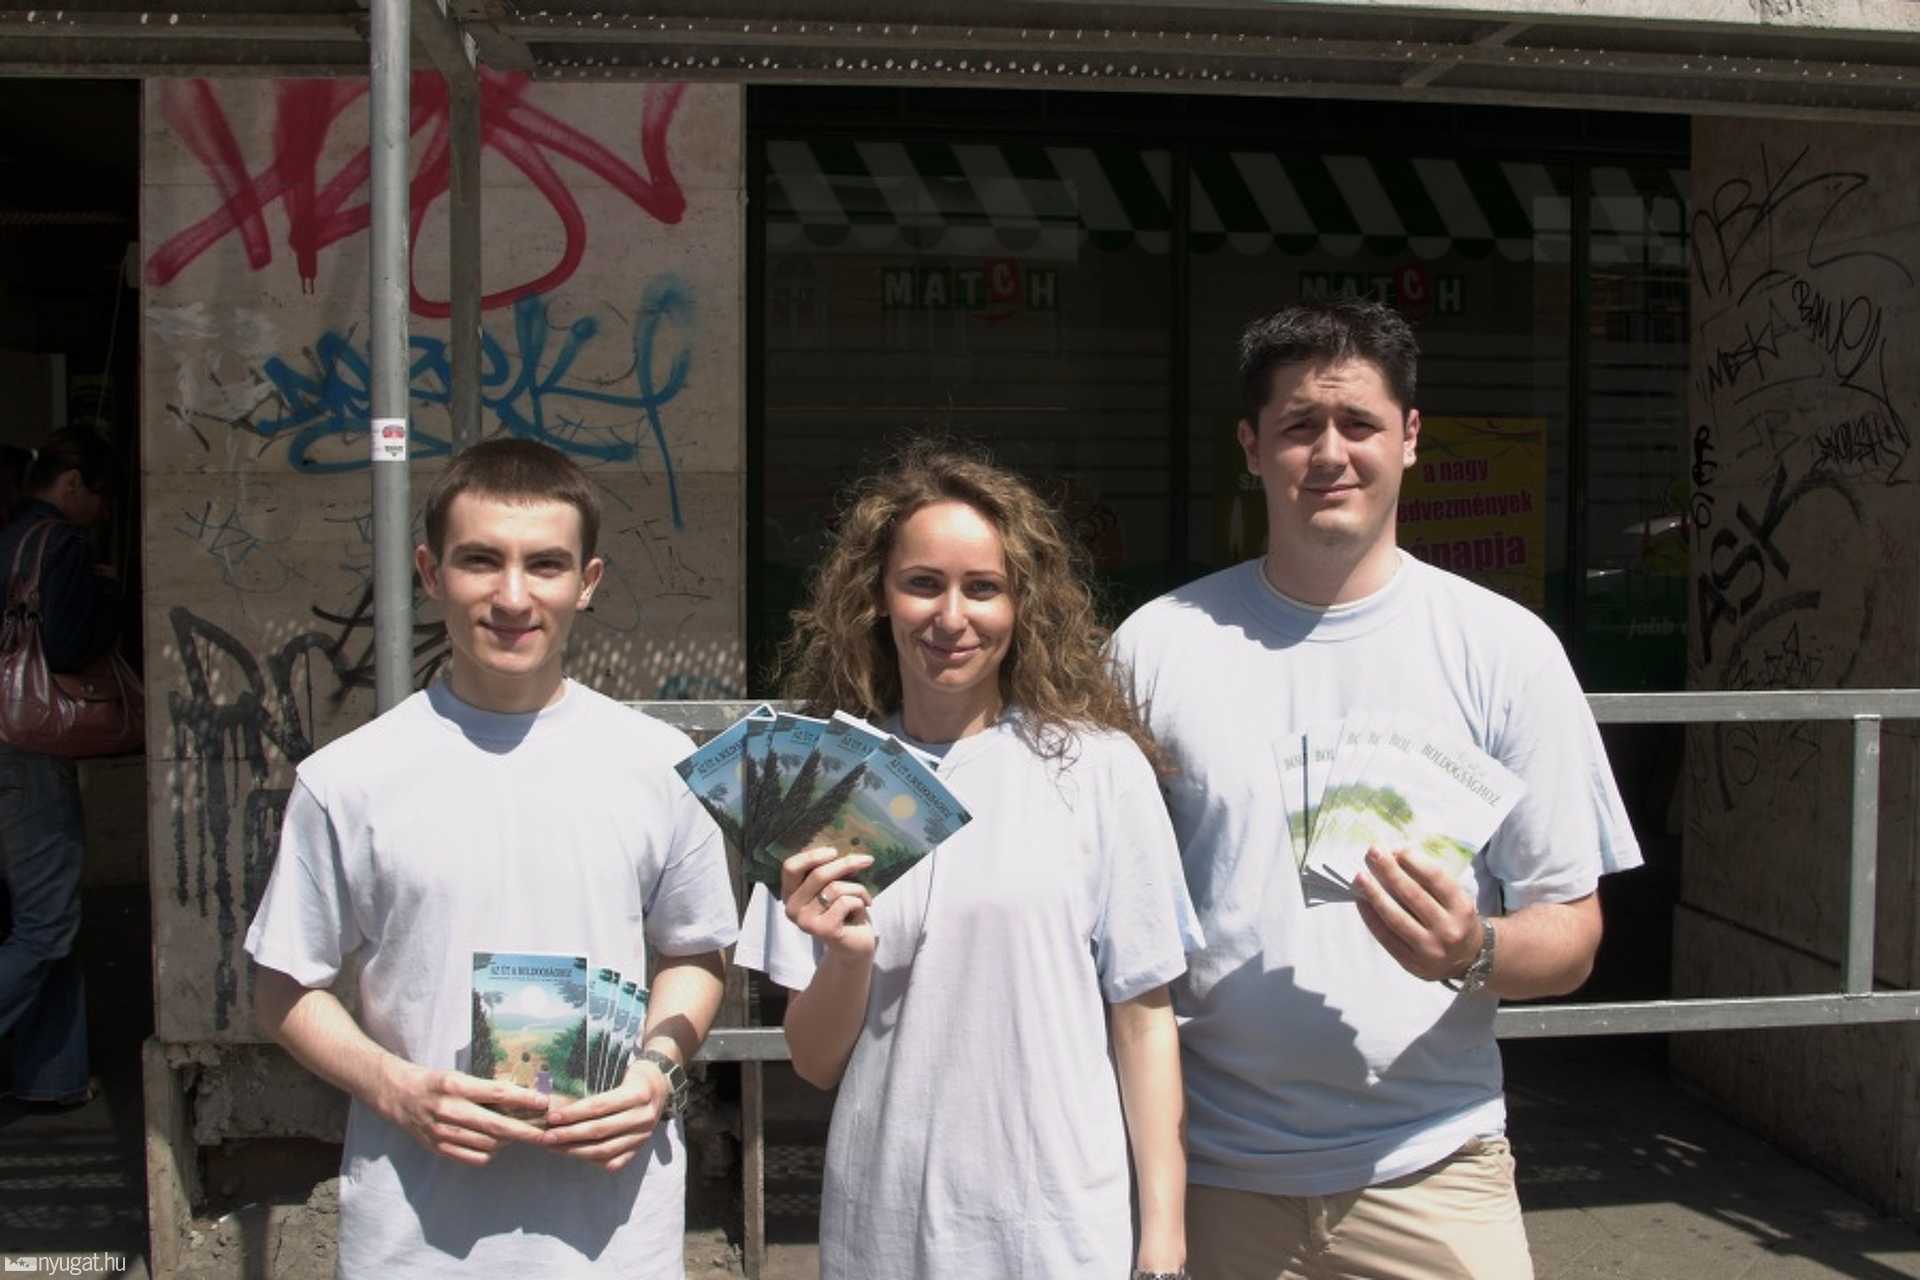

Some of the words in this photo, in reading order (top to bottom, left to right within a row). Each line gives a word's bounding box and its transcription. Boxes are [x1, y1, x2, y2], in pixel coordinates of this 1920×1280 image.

[884, 262, 1056, 308] MATCH
[1301, 267, 1461, 312] MATCH
[1424, 462, 1435, 483] a
[1440, 458, 1488, 483] nagy
[1398, 488, 1533, 523] edvezmények
[1410, 531, 1526, 571] ónapja
